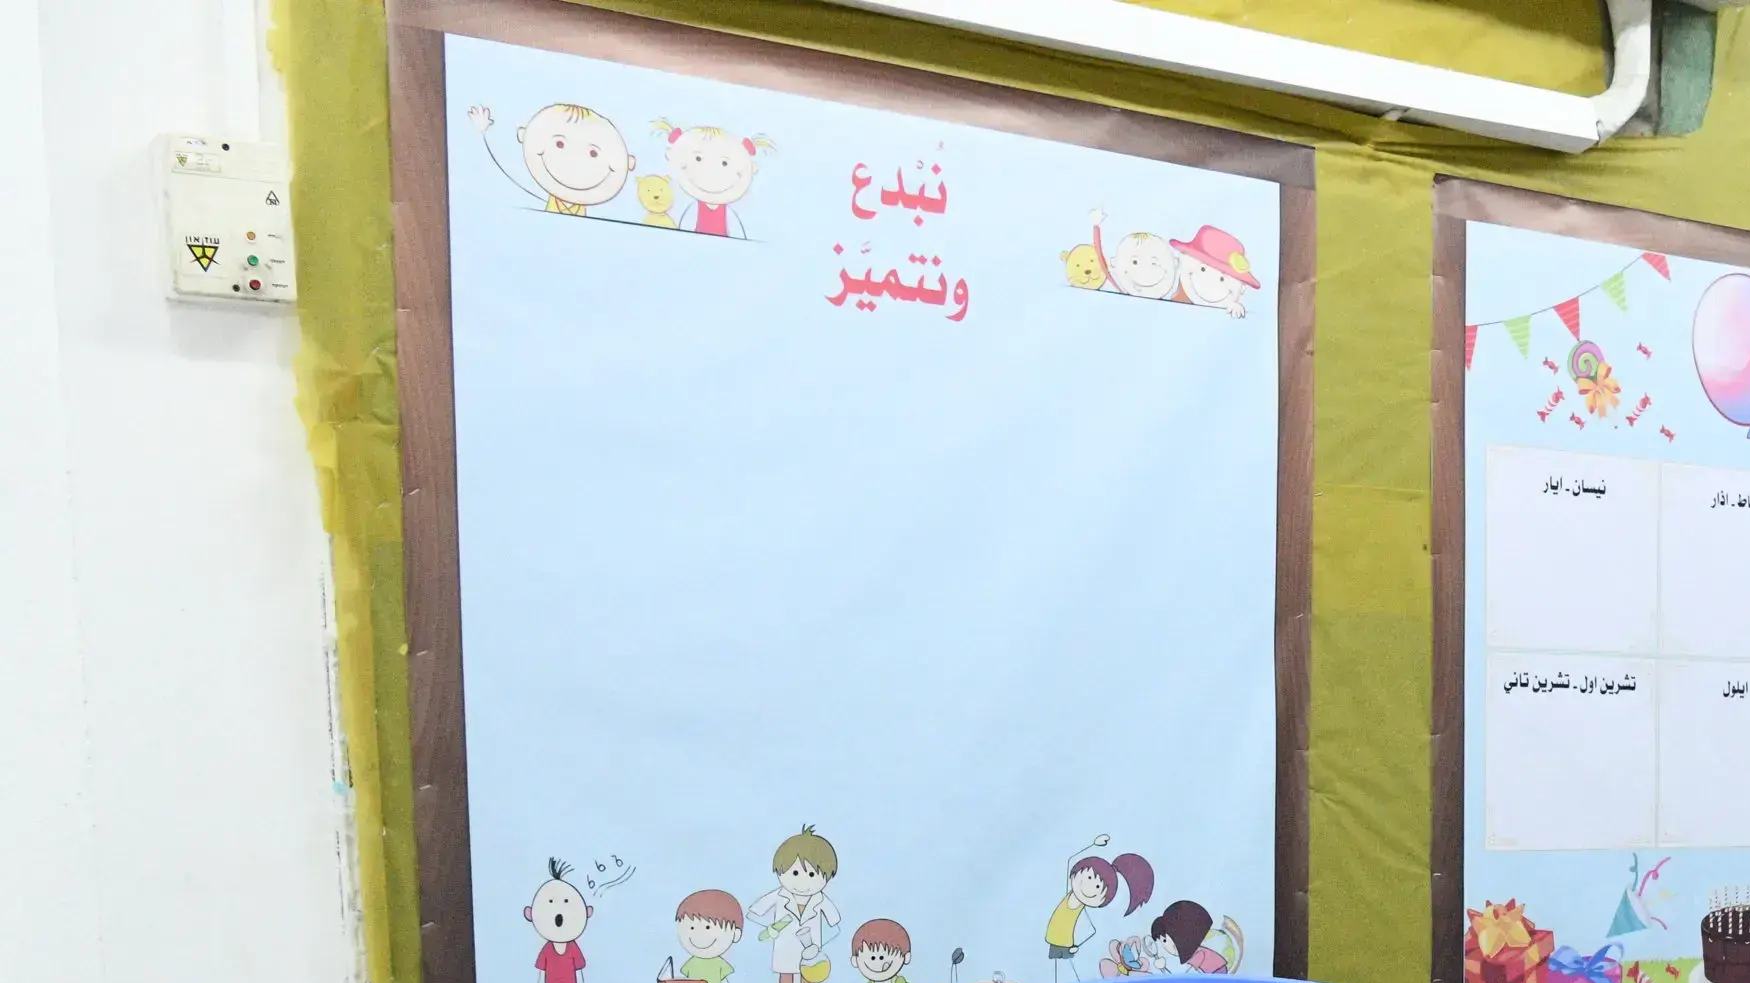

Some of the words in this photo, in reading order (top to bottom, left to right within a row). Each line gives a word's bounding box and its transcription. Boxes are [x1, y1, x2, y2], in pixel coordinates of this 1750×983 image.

[1543, 476, 1563, 495] ايار
[1572, 479, 1607, 499] نيسان
[1711, 490, 1729, 508] اذار
[1532, 671, 1571, 693] تشرين
[1580, 675, 1597, 694] اول
[1599, 673, 1637, 695] تشرين
[1722, 680, 1749, 699] ايلول
